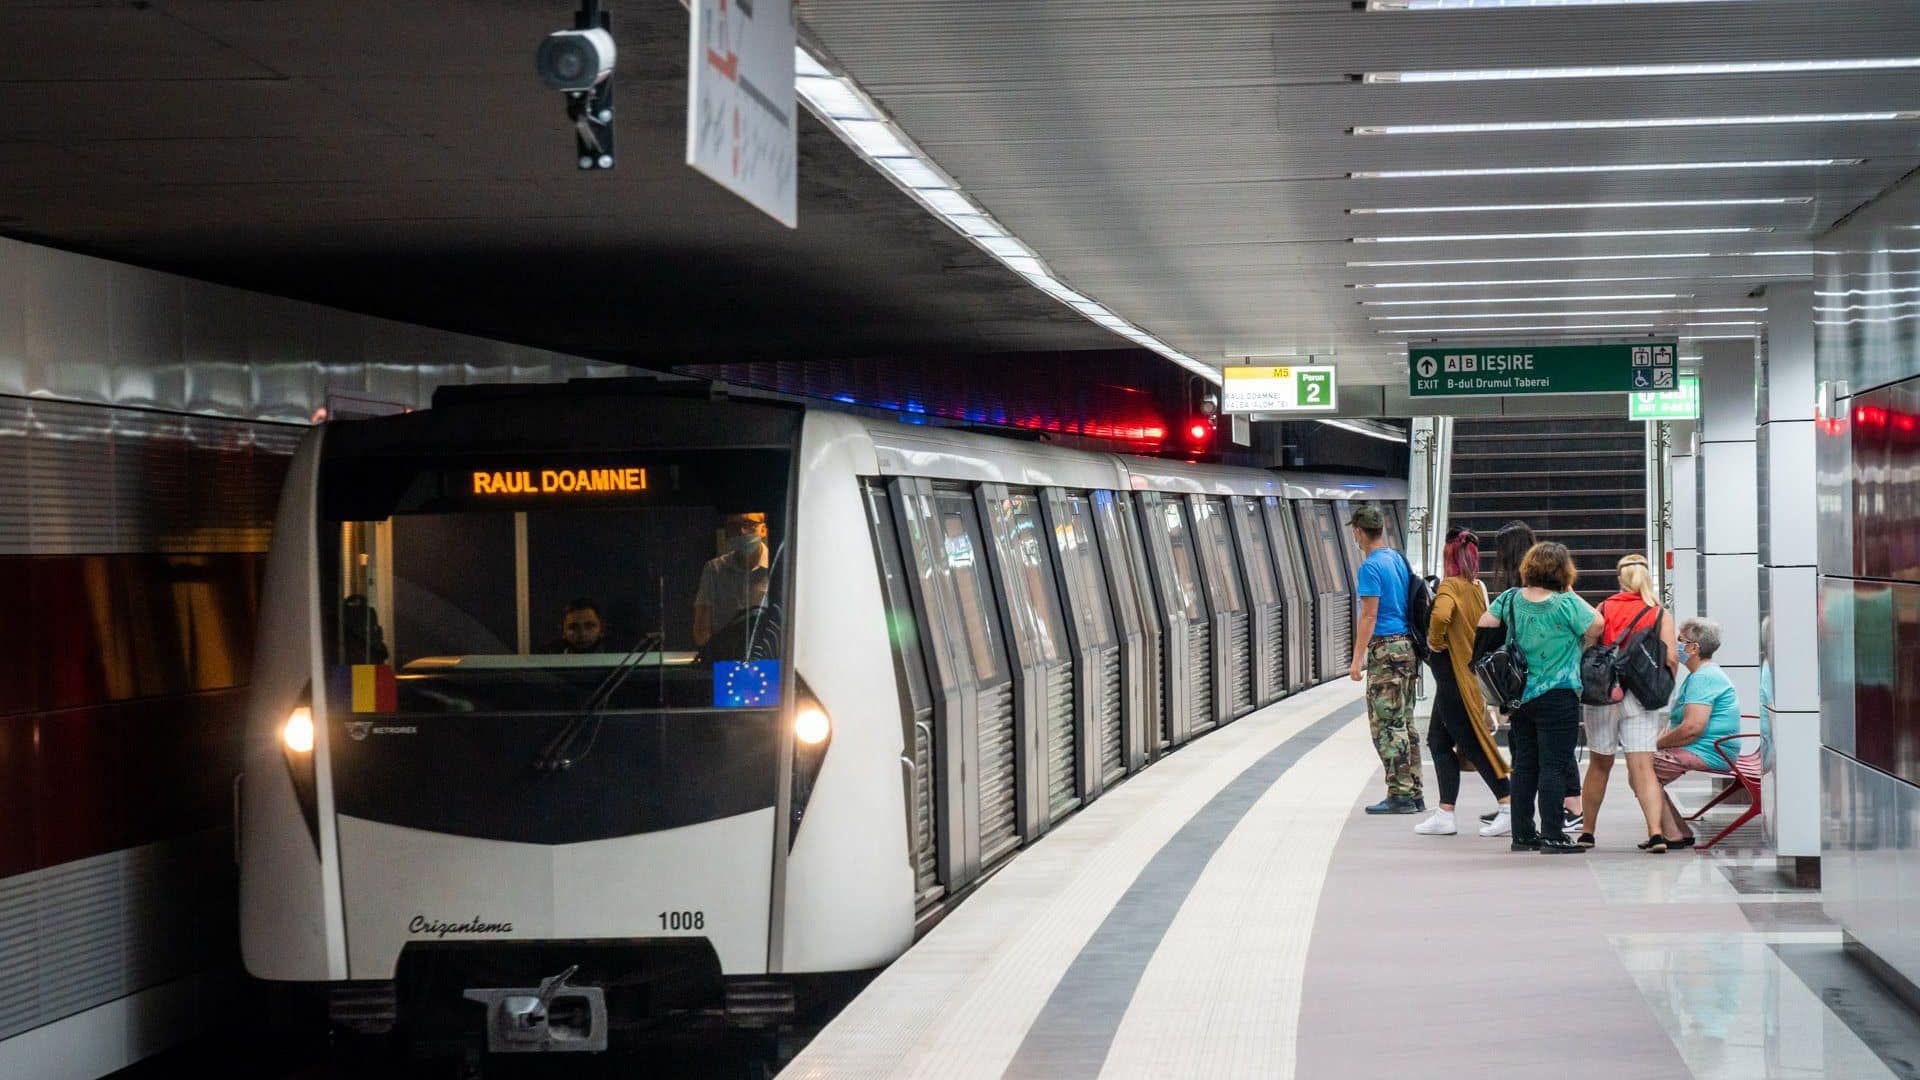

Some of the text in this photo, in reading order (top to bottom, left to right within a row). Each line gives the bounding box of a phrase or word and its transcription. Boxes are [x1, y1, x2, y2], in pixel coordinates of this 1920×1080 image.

[1448, 359, 1457, 369] A
[1465, 358, 1474, 369] B
[1273, 368, 1289, 377] M5
[1302, 373, 1325, 382] Peron
[1417, 379, 1439, 390] EXIT
[1447, 377, 1550, 389] B-dul Drumul Taberei
[1306, 383, 1320, 402] 2
[473, 468, 647, 493] RAUL DOAMNEI
[408, 915, 513, 938] Crizantema
[658, 911, 705, 930] 1008
